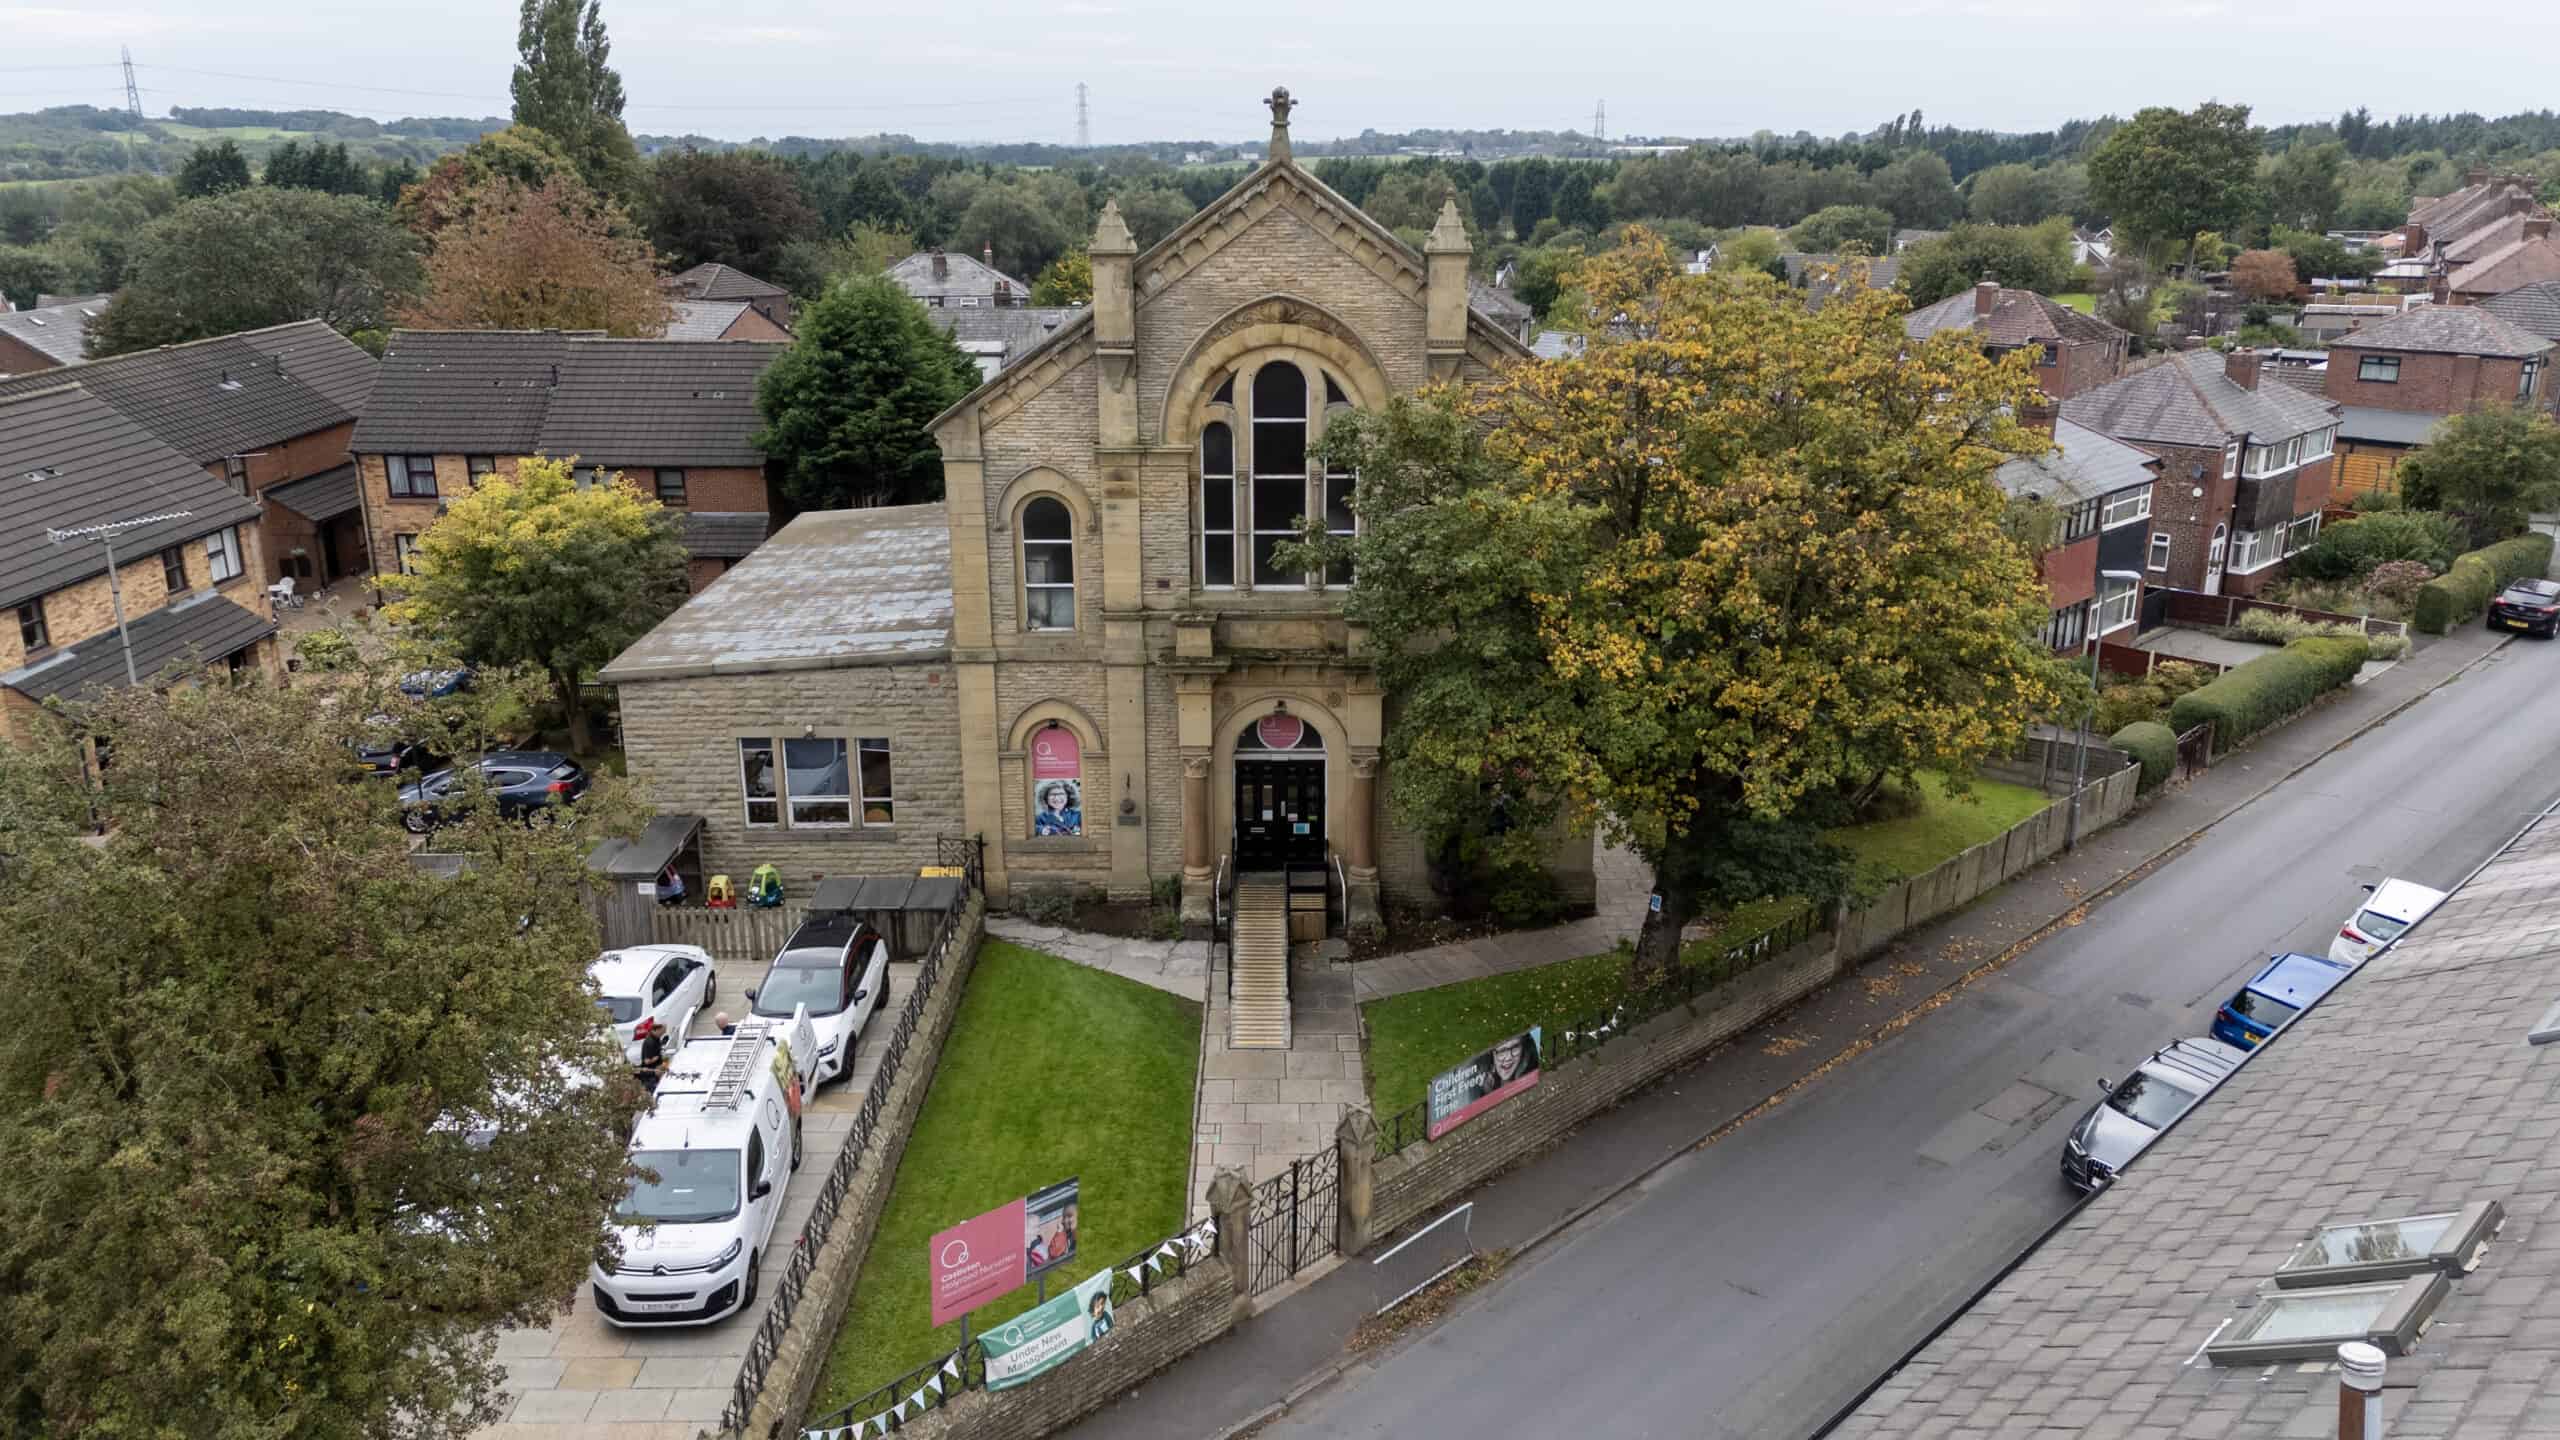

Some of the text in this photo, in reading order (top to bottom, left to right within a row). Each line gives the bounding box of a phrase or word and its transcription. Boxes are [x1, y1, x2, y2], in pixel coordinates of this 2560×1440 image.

[1434, 1064, 1478, 1092] Children
[1434, 1086, 1457, 1106] First
[1458, 1071, 1487, 1094] Every
[1007, 1336, 1068, 1374] Management
[1010, 1332, 1062, 1361] Under New
